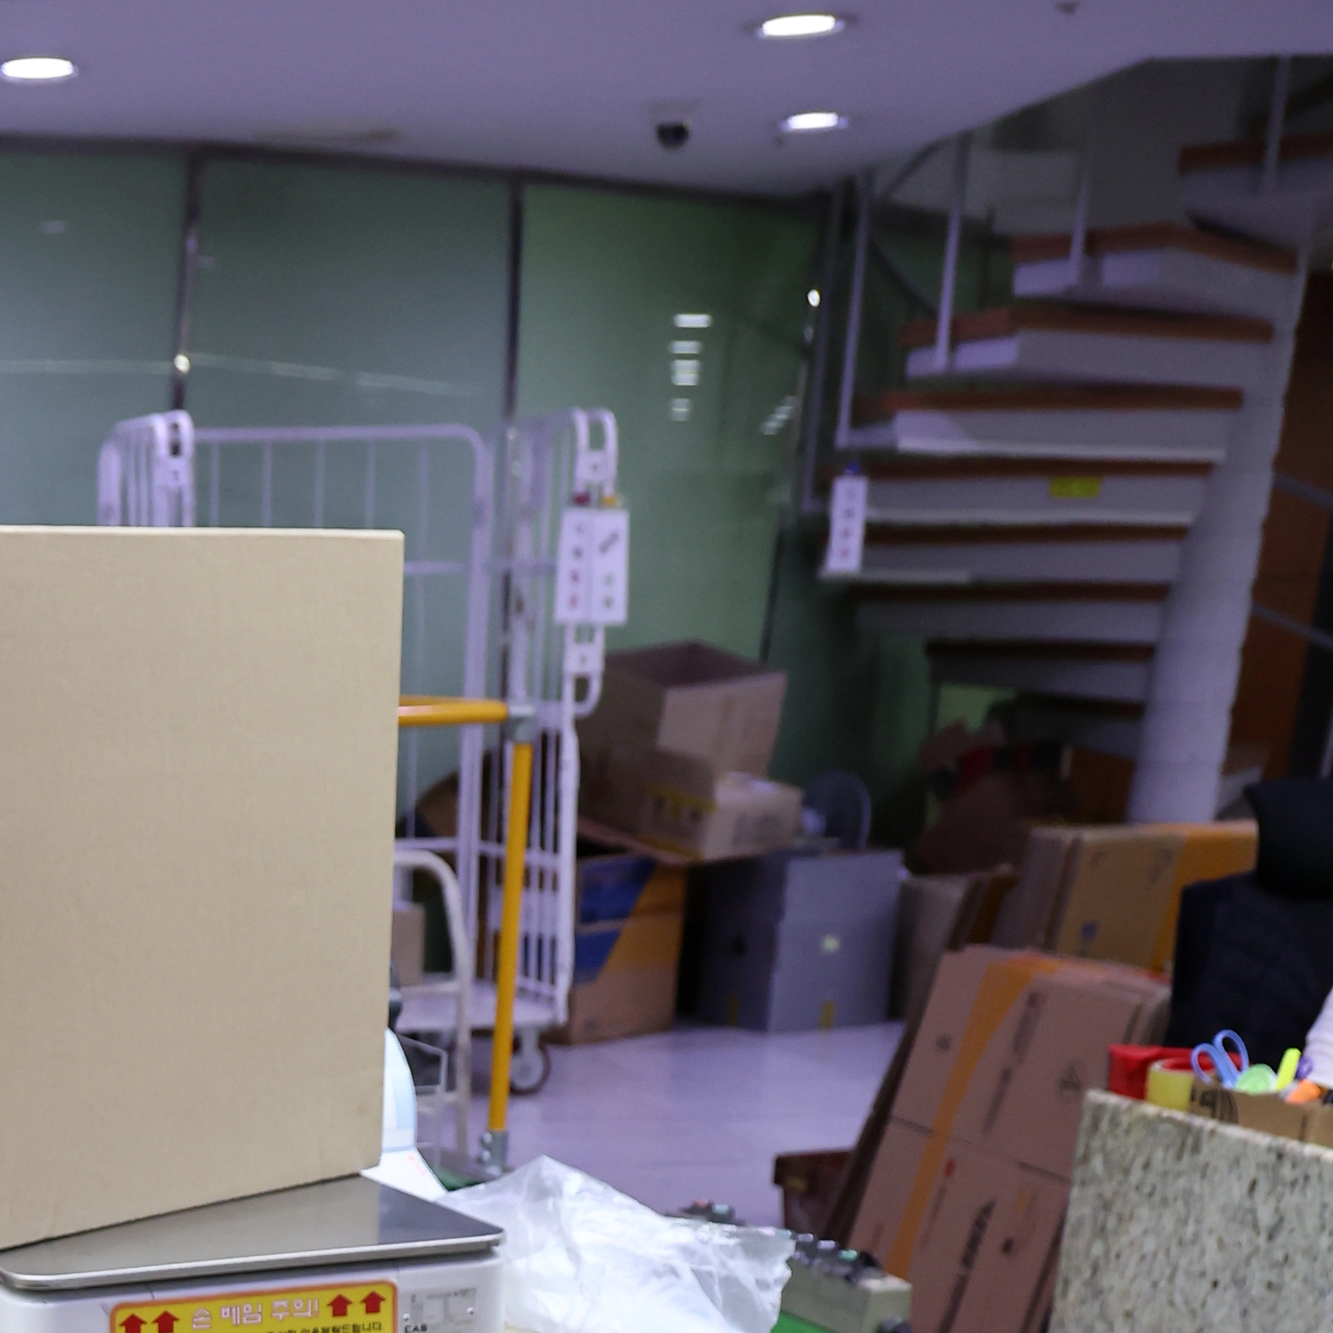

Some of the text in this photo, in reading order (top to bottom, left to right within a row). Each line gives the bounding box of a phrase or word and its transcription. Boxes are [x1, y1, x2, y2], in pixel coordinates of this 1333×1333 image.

[191, 1296, 318, 1329] 손 베임 주의!
